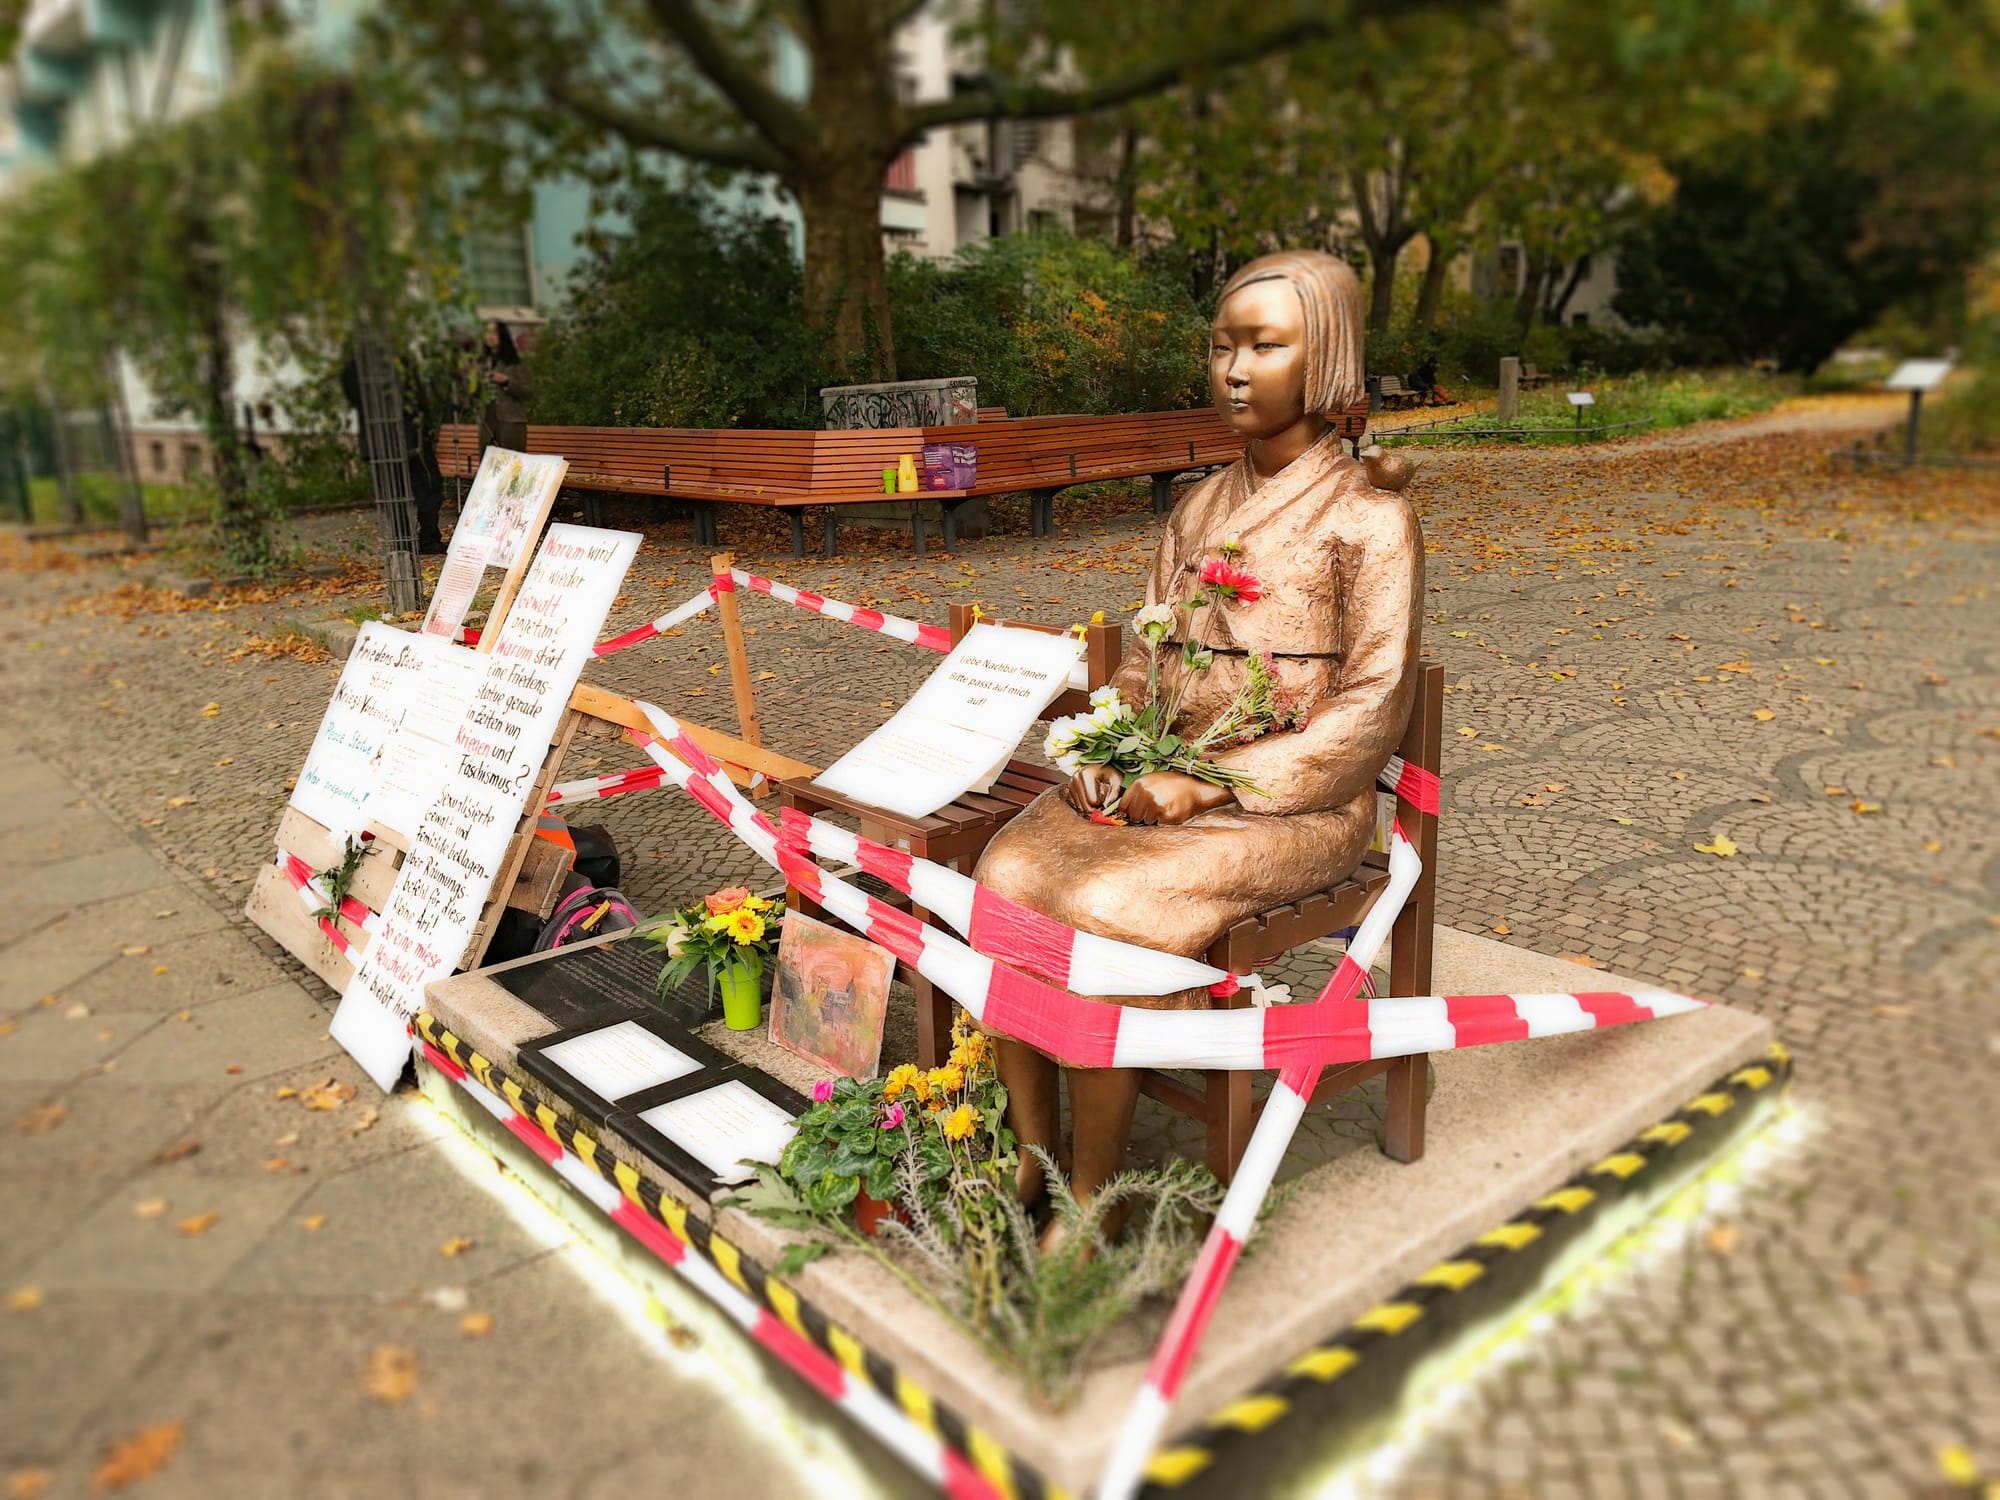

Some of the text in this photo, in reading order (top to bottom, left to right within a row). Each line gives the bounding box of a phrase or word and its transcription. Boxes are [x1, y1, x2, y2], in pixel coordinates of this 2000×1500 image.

[544, 534, 620, 564] Warum wird
[549, 565, 586, 589] wieder
[517, 591, 562, 618] Gewalt
[511, 617, 568, 643] angetan?
[496, 640, 566, 670] Warum stört
[960, 656, 981, 667] Liebe
[486, 661, 553, 696] eine Friedens-
[949, 672, 1031, 698] Bitte passt auf mich
[476, 682, 543, 719] statue gerade
[967, 696, 987, 707] auf!
[465, 704, 522, 740] in Zeiten von
[455, 724, 516, 764] Kriegen und
[305, 764, 320, 784] War
[458, 754, 531, 797] Faschismus?
[434, 784, 495, 827] Sexualisierte
[455, 824, 473, 841] und
[447, 842, 490, 880] beklagen-
[402, 872, 430, 900] befehl
[441, 900, 466, 926] diese
[382, 920, 441, 969] So eine miese
[358, 961, 372, 984] Ari
[370, 974, 396, 1009] bleibt
